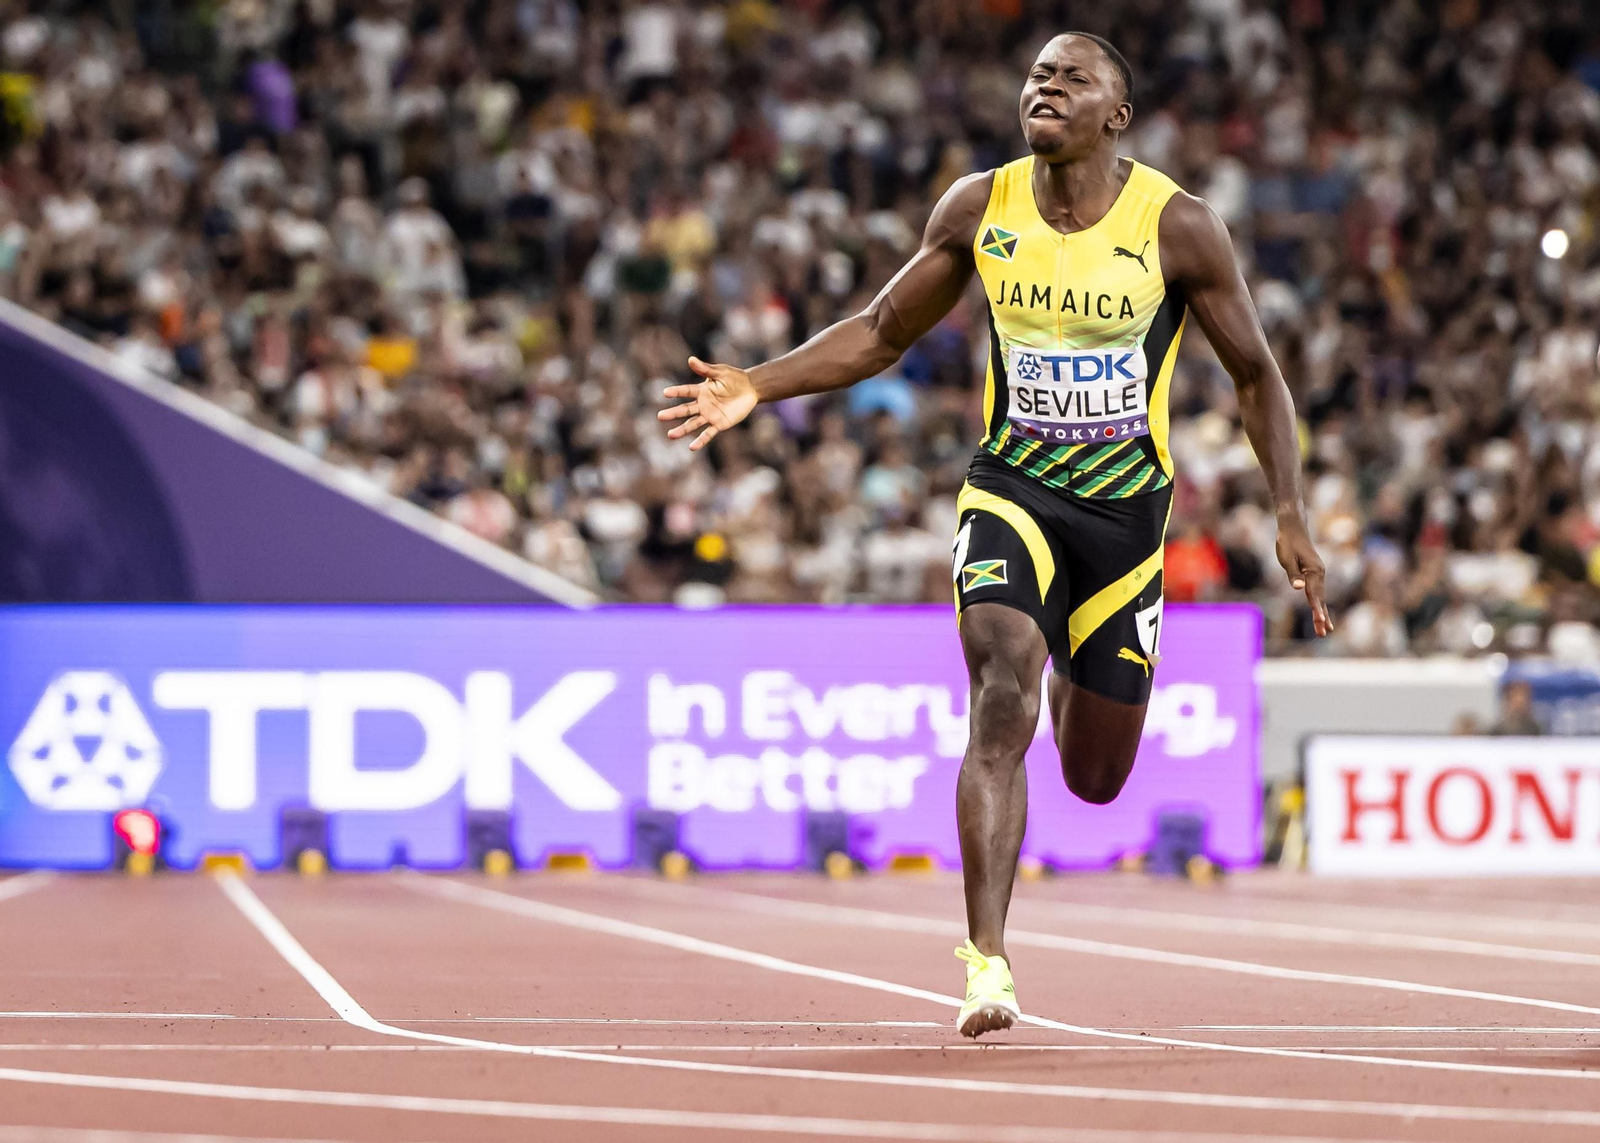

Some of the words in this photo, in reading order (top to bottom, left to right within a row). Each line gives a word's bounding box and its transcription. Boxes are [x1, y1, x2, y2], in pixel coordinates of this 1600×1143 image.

[996, 280, 1135, 320] JAMAICA
[1041, 353, 1136, 382] TDK
[1016, 384, 1138, 418] SEVILLE
[1148, 612, 1159, 654] 7
[648, 672, 726, 739] In
[153, 670, 621, 811] TDK
[648, 741, 929, 813] Better
[1340, 765, 1600, 846] HON
